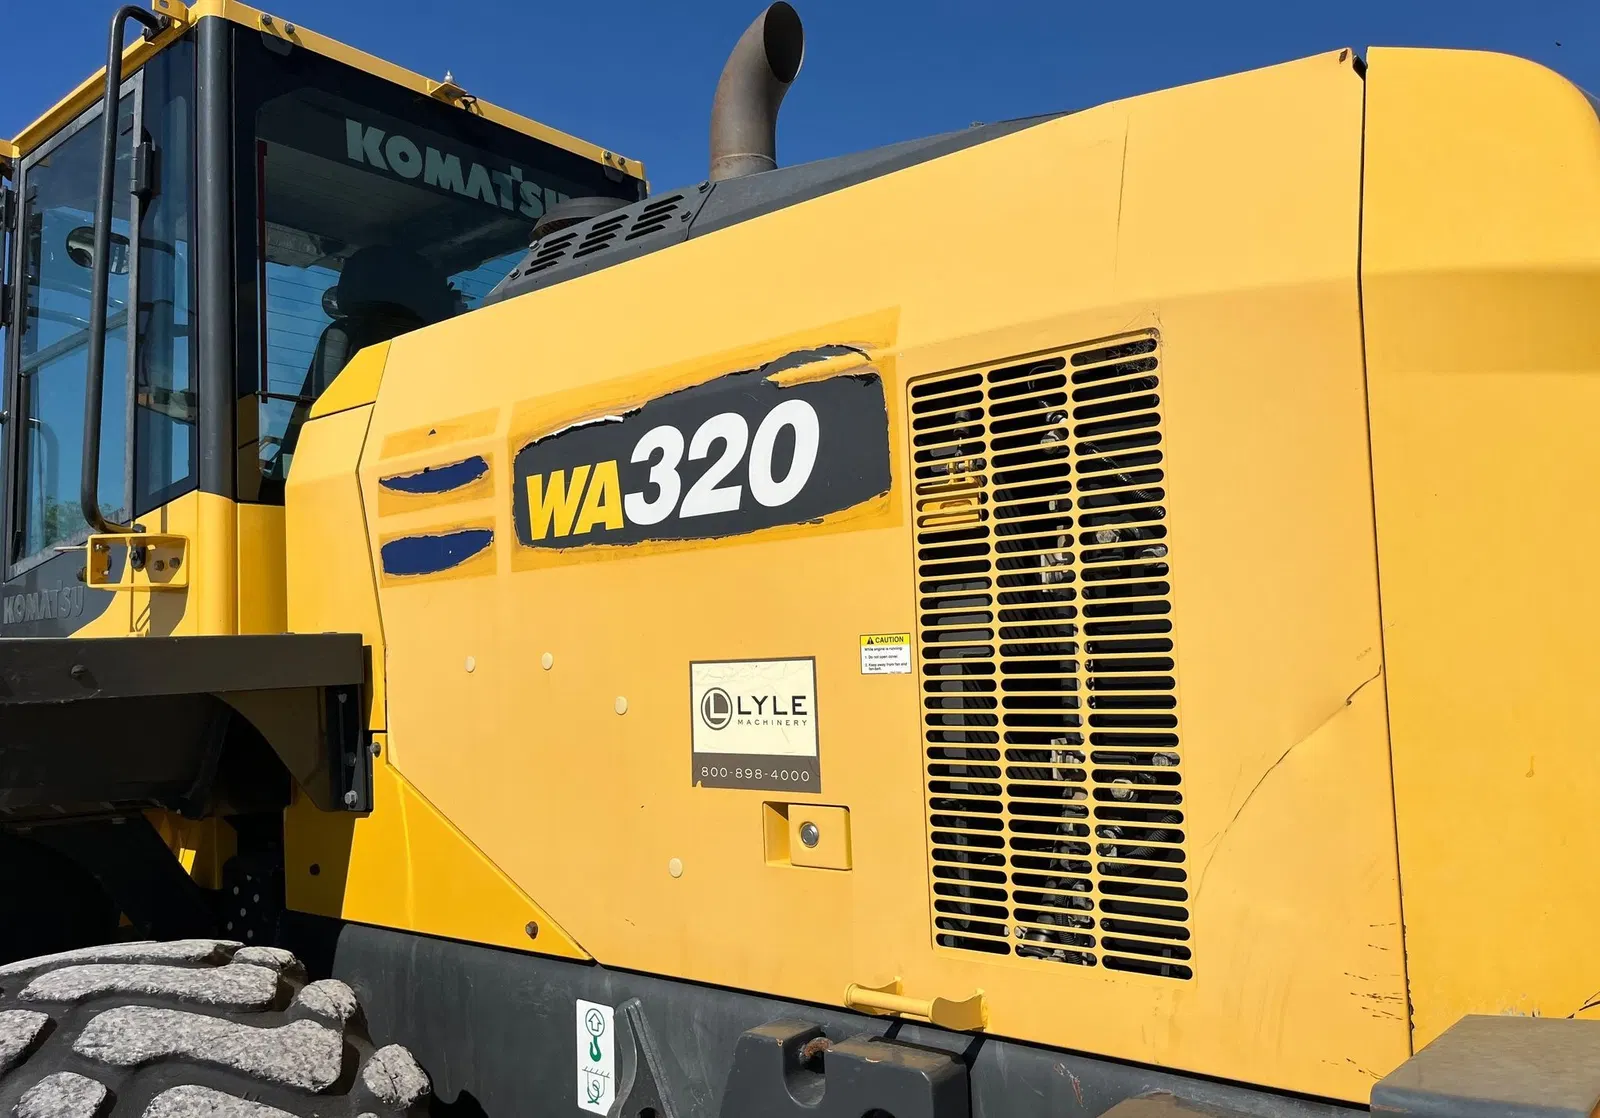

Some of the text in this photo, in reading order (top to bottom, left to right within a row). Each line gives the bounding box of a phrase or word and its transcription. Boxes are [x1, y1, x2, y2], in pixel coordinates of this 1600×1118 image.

[3, 579, 84, 624] KOMATSU
[737, 695, 808, 716] LYLE
[701, 766, 810, 782] 800-898-4000
